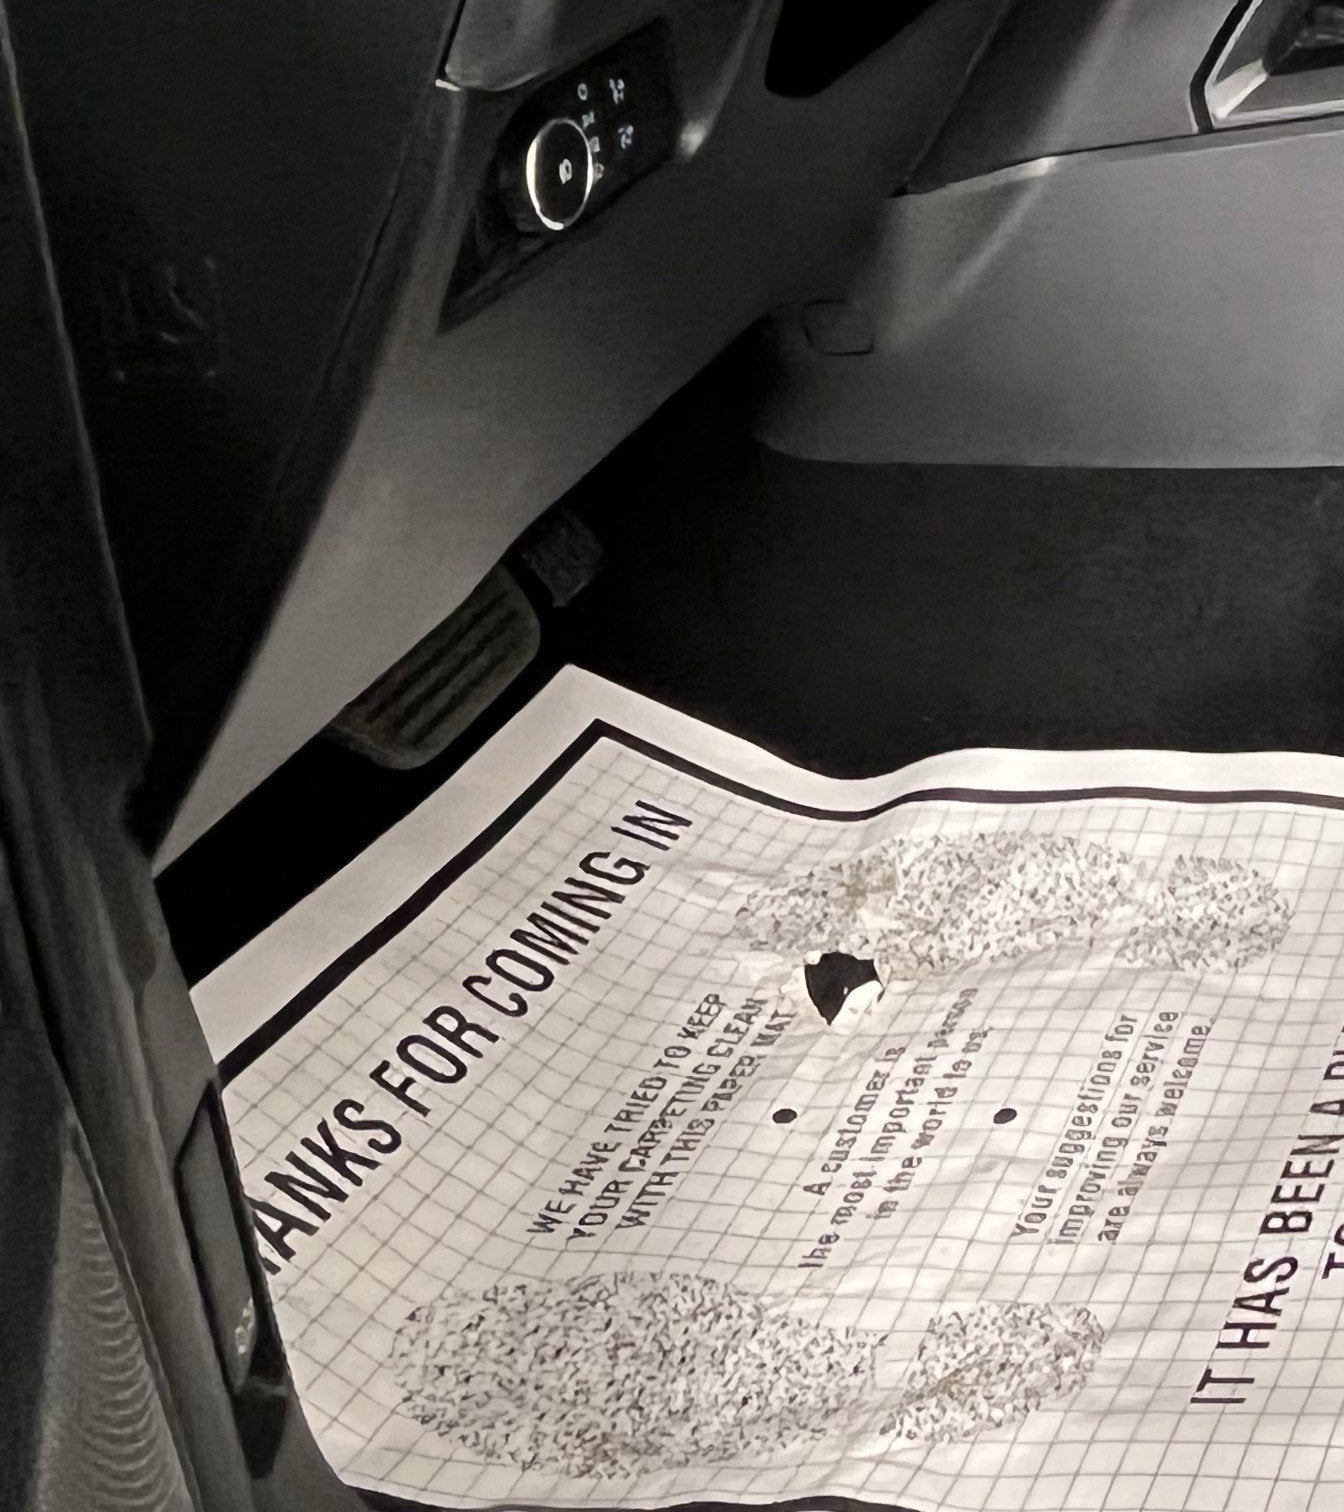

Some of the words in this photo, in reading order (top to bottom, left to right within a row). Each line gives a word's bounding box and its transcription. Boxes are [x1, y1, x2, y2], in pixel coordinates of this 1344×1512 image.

[248, 1098, 402, 1276] ANKS
[369, 1005, 500, 1118] FOR
[462, 851, 650, 1017] COMING
[610, 800, 693, 852] IN
[526, 1199, 577, 1234] WE
[558, 1141, 623, 1196] HAVE
[604, 1076, 667, 1133] TRIED
[653, 1045, 692, 1070] TO
[677, 993, 726, 1039] KEEP
[567, 1179, 633, 1239] YOUR
[618, 1062, 721, 1172] CARPETING
[706, 997, 767, 1058] CLEAN
[615, 1171, 679, 1230] WITH
[660, 1118, 716, 1166] THIS
[701, 1055, 767, 1112] PAPER
[750, 1009, 797, 1047] MAT
[802, 1181, 832, 1196] A
[821, 1069, 890, 1173] customer
[883, 1156, 922, 1193] the
[911, 1086, 958, 1150] world
[1010, 1184, 1057, 1238] Your
[1045, 1050, 1123, 1179] suggestions
[1105, 1014, 1138, 1043] for
[1053, 1136, 1129, 1244] improving
[1111, 1092, 1142, 1128] our
[1130, 1012, 1180, 1088] service
[797, 1231, 840, 1268] the
[830, 1170, 877, 1226] most
[858, 1055, 938, 1162] important
[1098, 1205, 1131, 1242] are
[1117, 1125, 1169, 1197] always
[1189, 1368, 1256, 1405] IT
[1215, 1256, 1299, 1349] HAS
